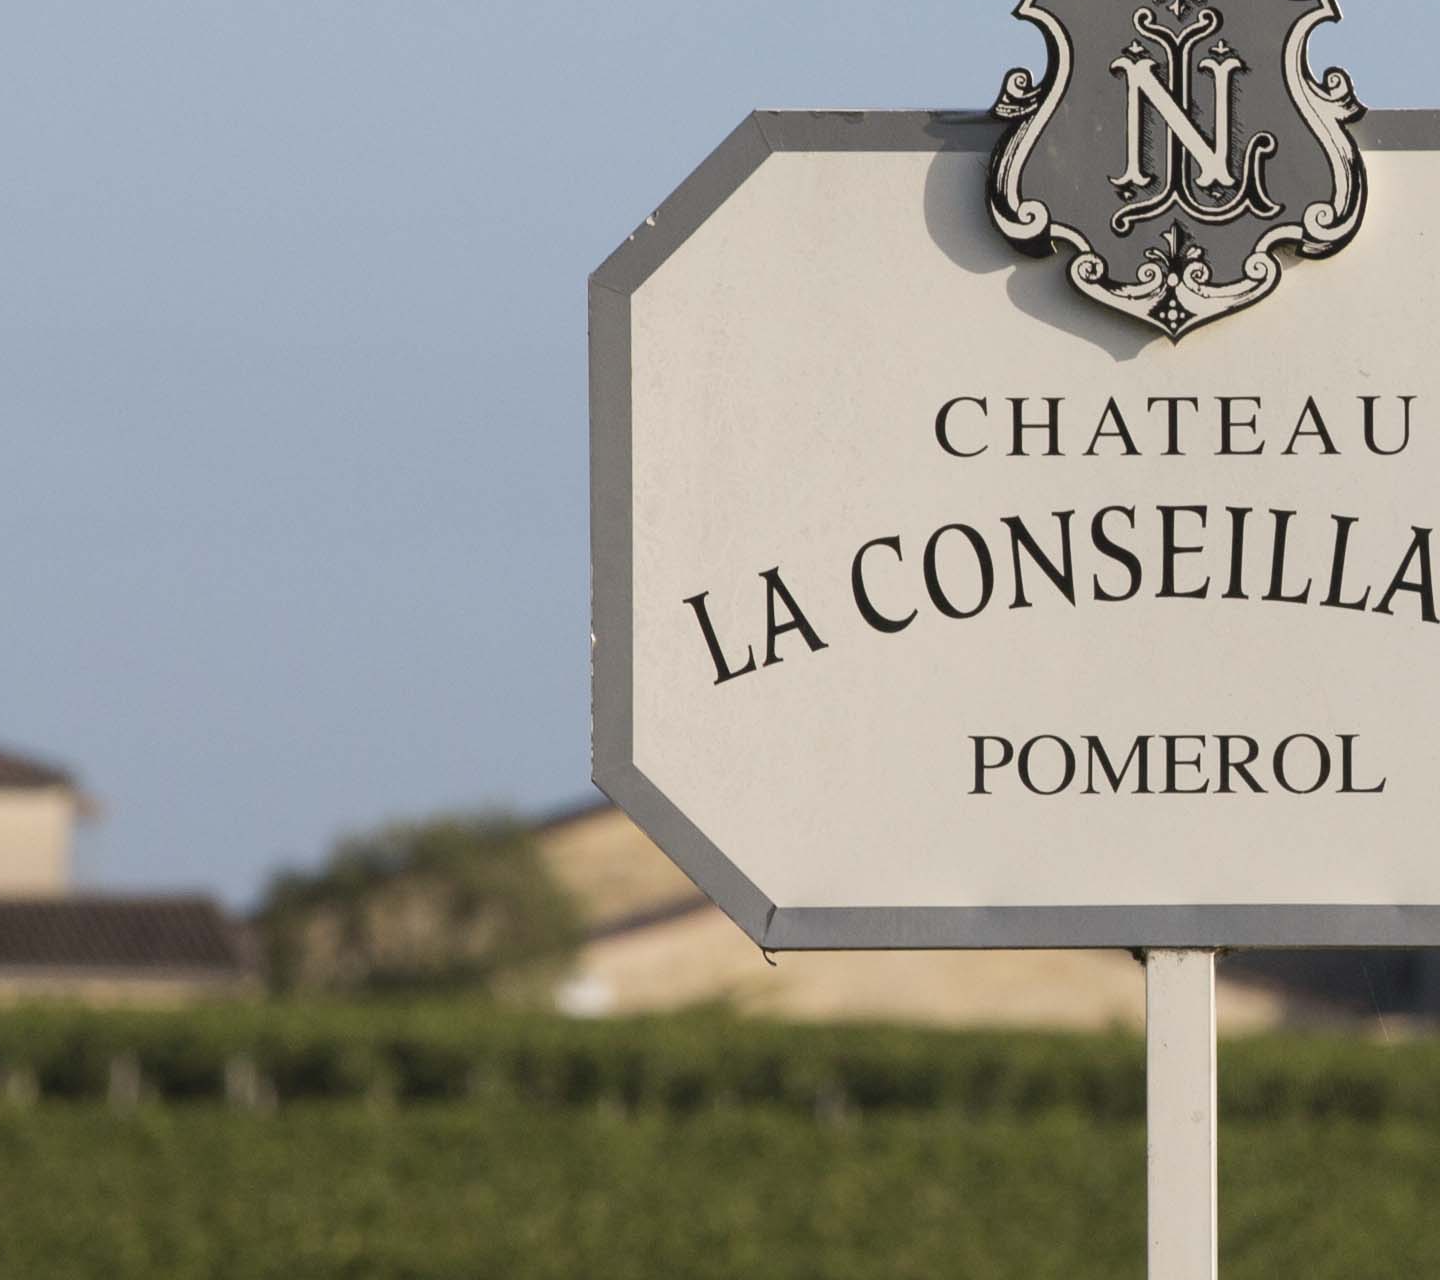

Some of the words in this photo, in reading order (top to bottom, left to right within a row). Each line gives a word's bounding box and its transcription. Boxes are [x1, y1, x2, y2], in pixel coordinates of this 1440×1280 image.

[934, 395, 1417, 458] CHATEAU
[682, 565, 829, 686] LA
[967, 733, 1387, 796] POMEROL
